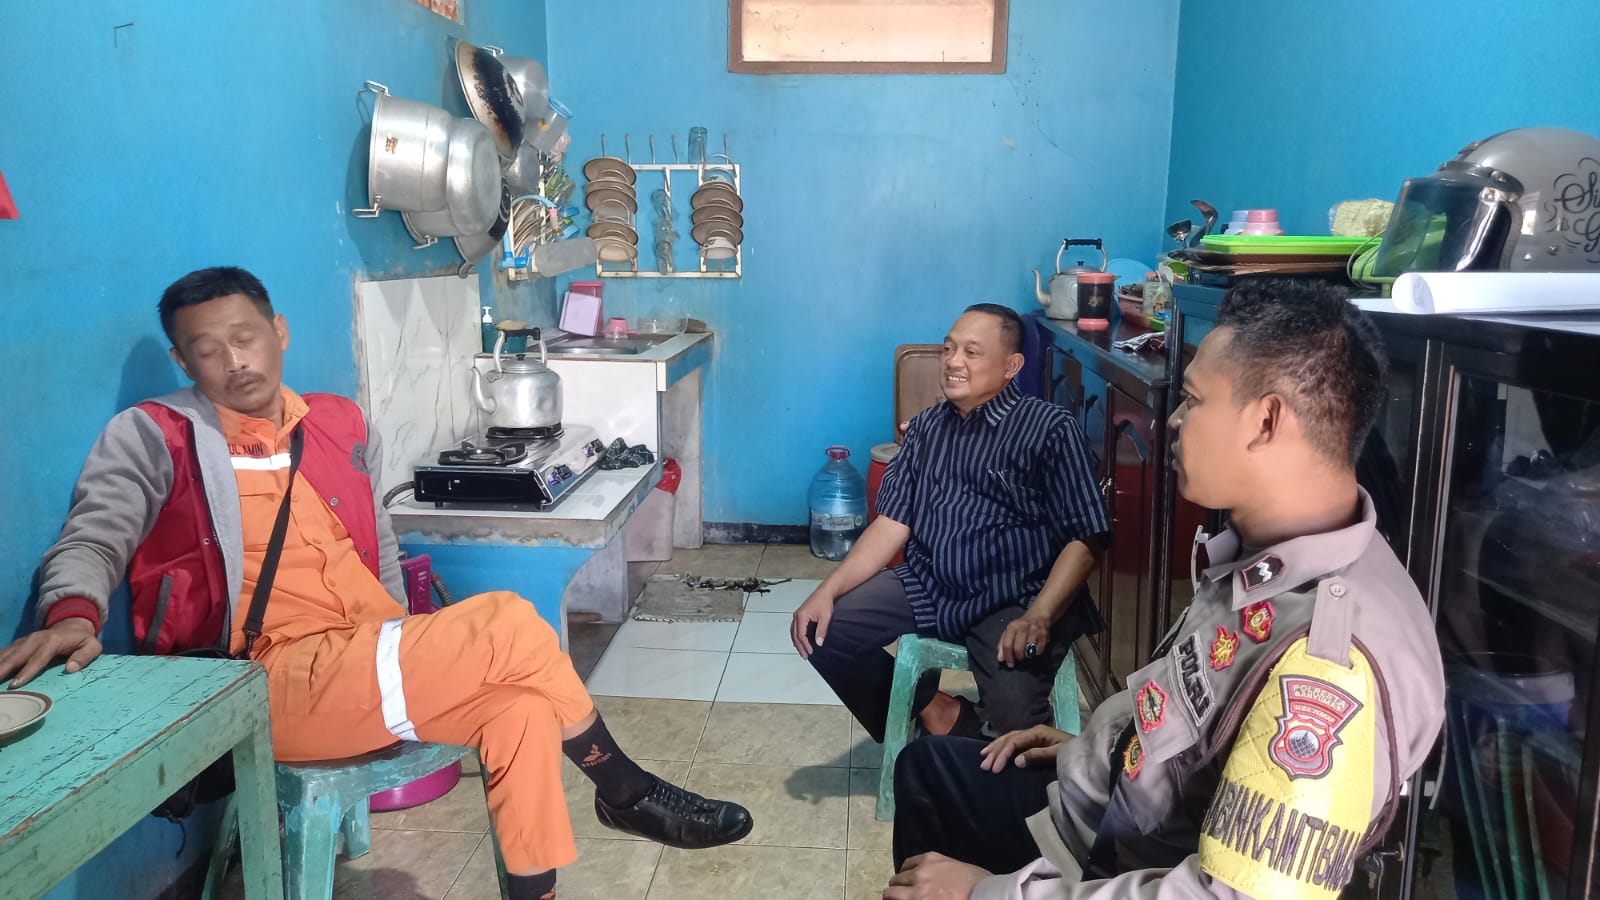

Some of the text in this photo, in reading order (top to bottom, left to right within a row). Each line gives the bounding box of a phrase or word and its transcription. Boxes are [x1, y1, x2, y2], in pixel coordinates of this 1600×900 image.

[228, 443, 241, 455] UL
[1293, 684, 1345, 709] POLRESTA
[1294, 691, 1341, 711] BANYUMAS
